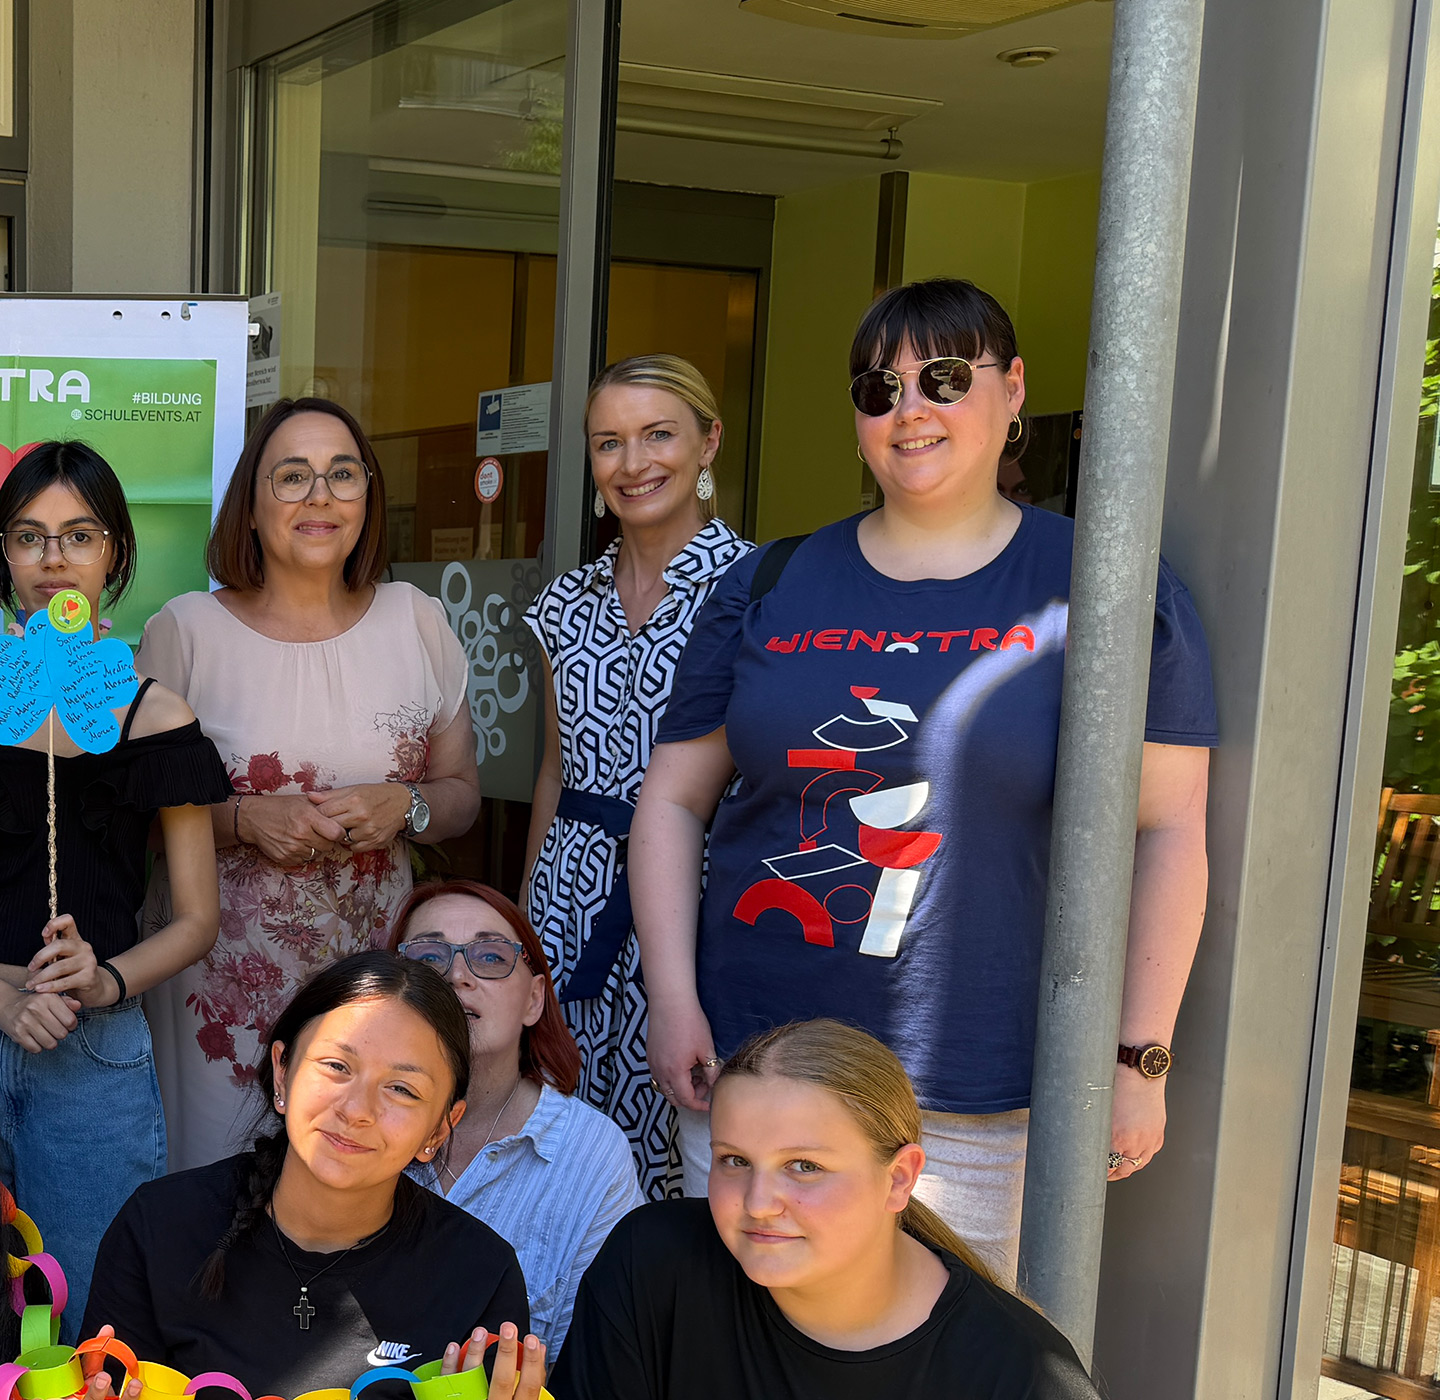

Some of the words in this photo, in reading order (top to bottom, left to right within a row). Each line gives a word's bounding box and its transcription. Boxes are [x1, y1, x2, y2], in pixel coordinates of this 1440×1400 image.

[131, 392, 202, 406] #BILDUNG
[84, 409, 202, 423] SCHULEVENTS.AT
[765, 625, 1036, 654] WIENXTRA
[375, 1340, 411, 1359] NIKE
